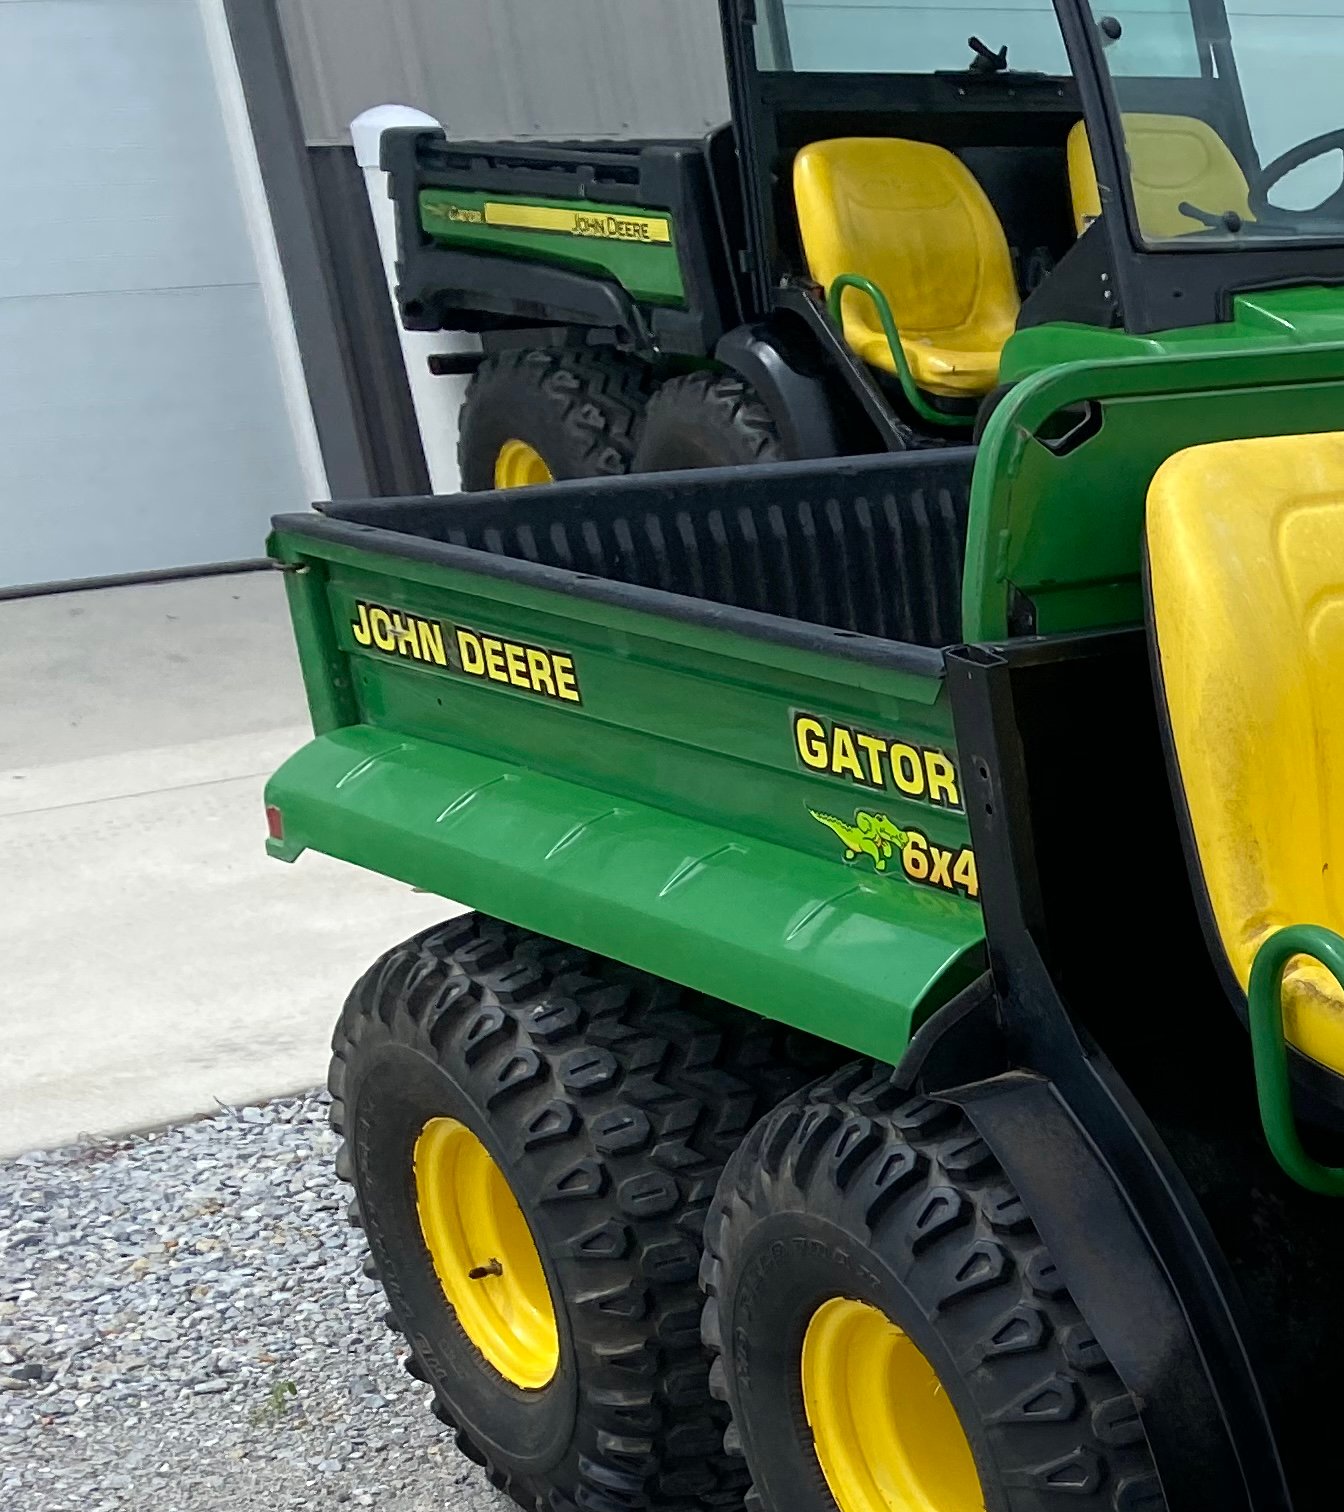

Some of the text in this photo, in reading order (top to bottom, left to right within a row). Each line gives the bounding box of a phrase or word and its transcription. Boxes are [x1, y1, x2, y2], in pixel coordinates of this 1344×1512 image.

[574, 213, 649, 239] JOHN DEERE
[352, 604, 580, 702] JOHN DEERE
[796, 717, 959, 805] GATOR
[902, 830, 979, 897] 6x4
